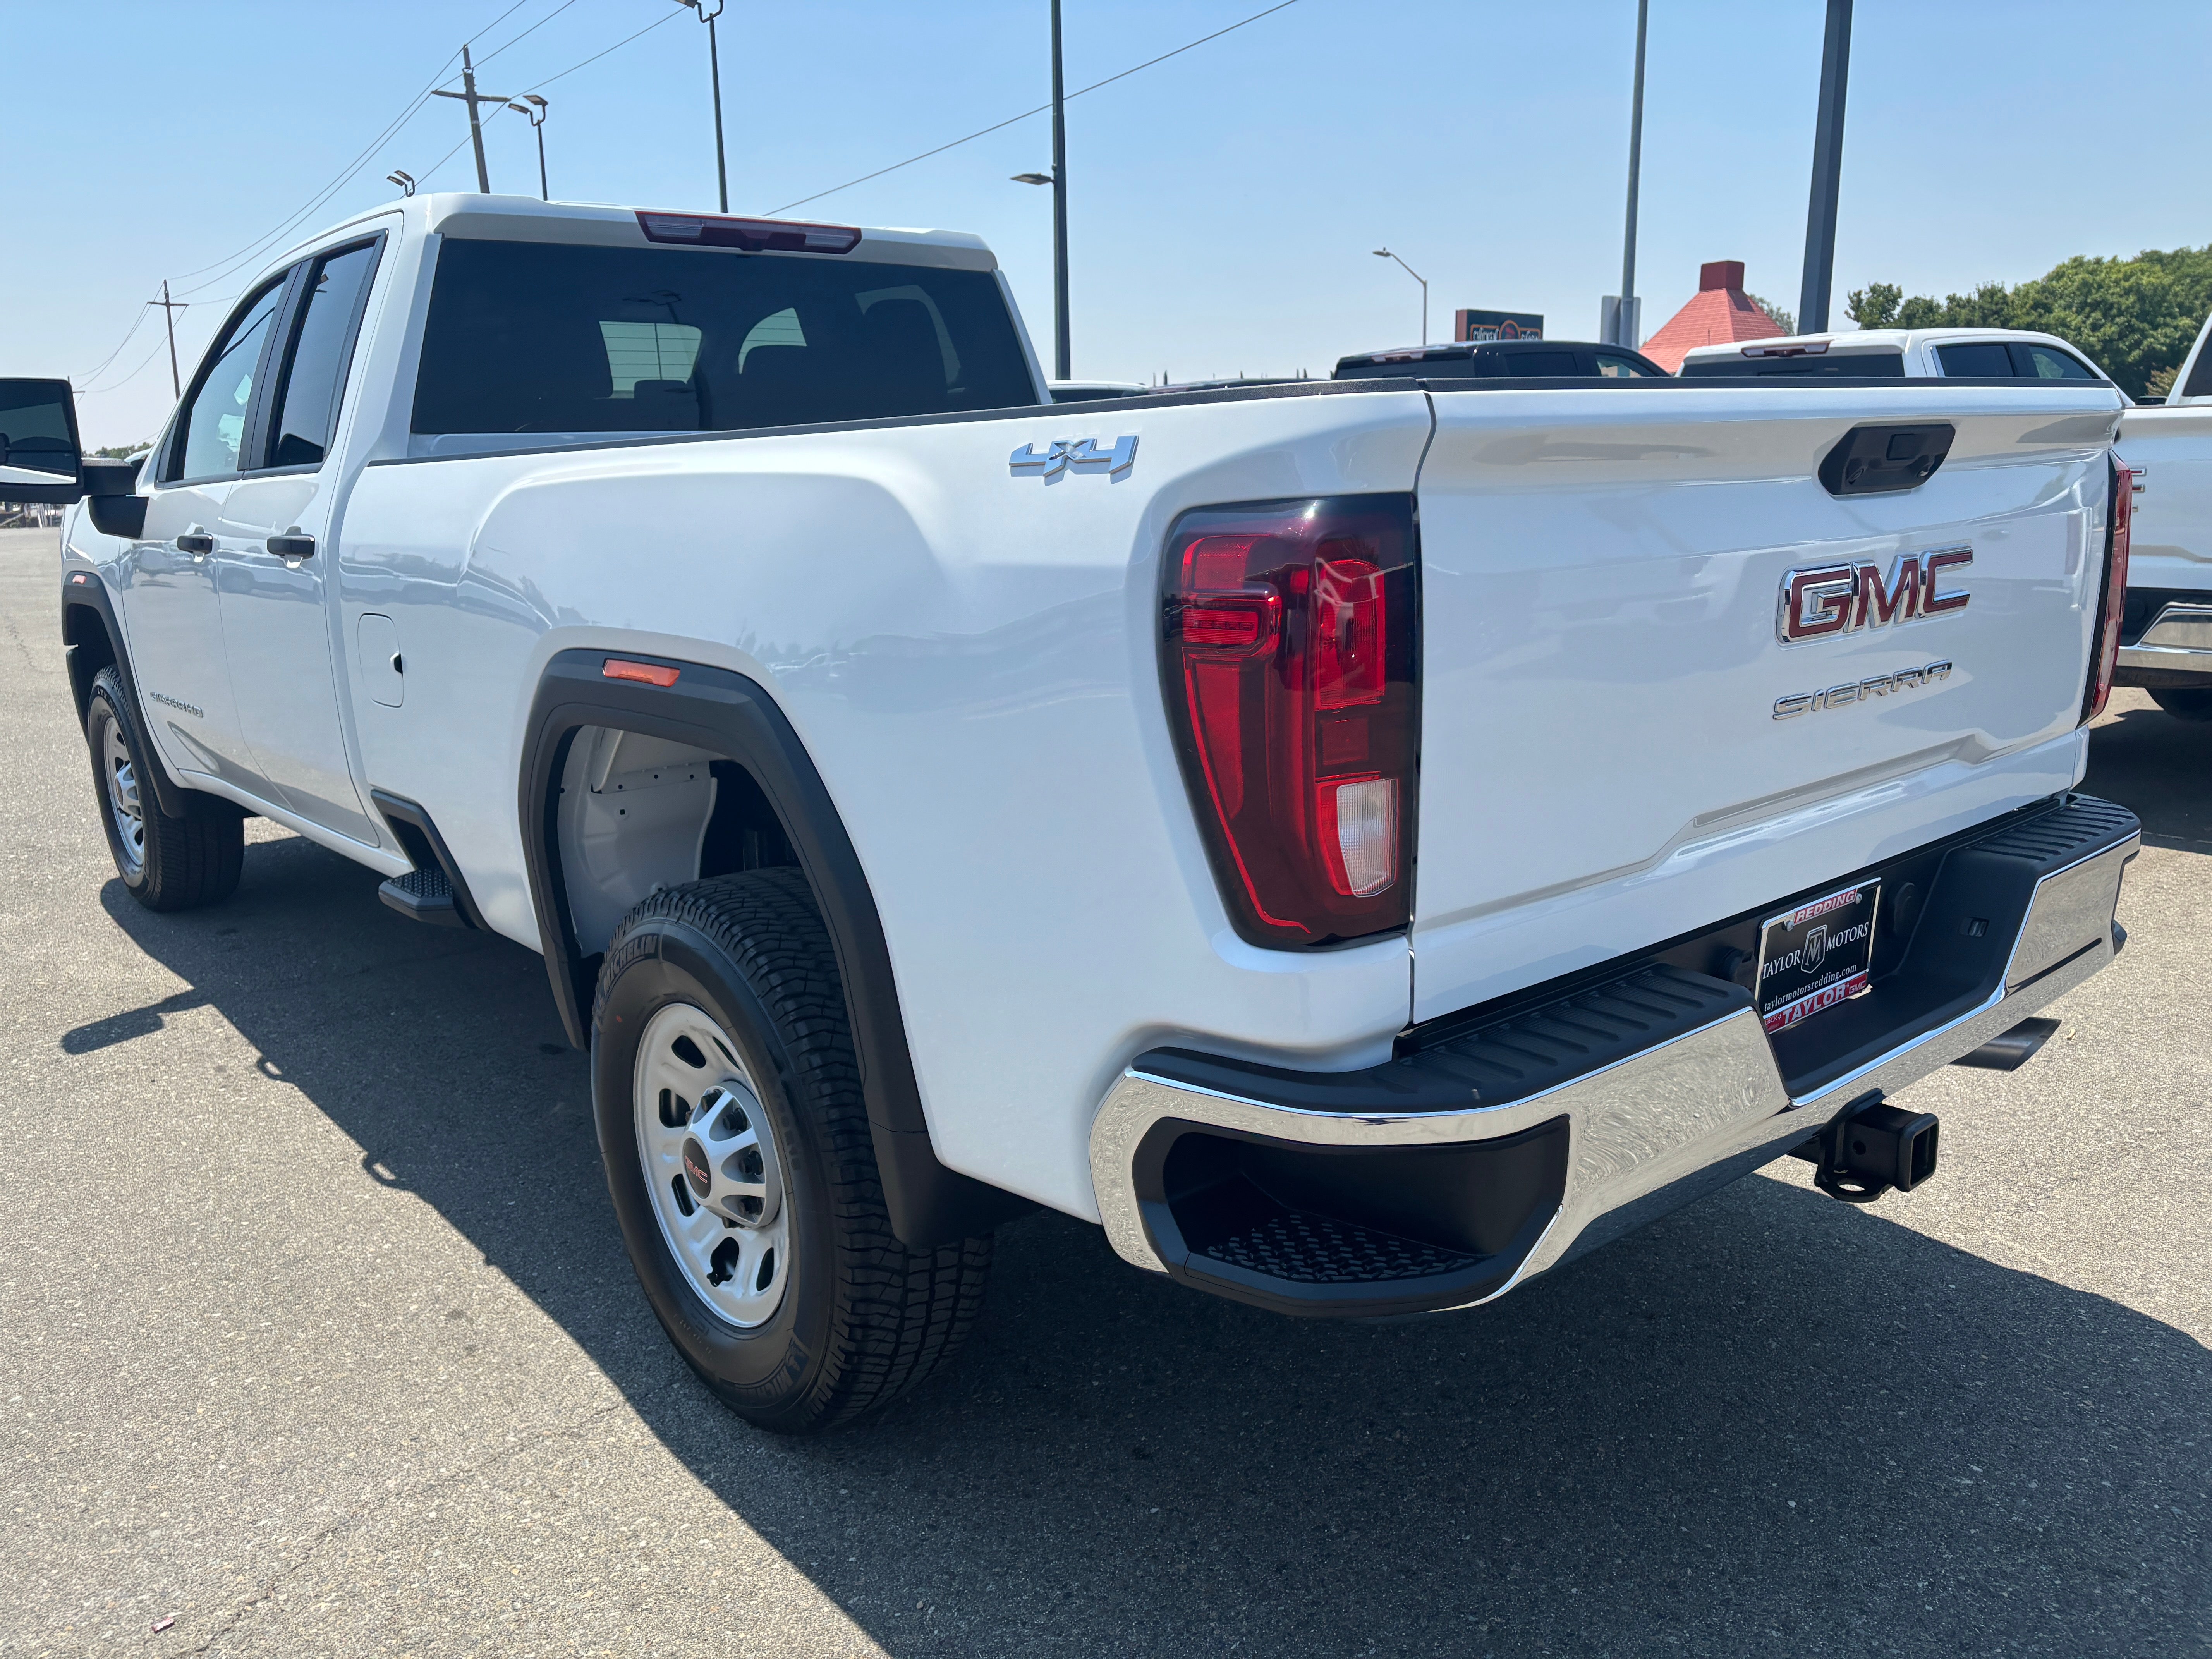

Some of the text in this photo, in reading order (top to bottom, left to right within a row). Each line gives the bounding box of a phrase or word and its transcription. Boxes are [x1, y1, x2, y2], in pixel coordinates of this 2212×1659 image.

[1776, 545, 1973, 646] GMC
[1772, 659, 1952, 720] SIERRA
[1796, 892, 1856, 922] REDDING
[1763, 950, 1801, 979] TAYLOR
[1826, 922, 1869, 951] MOTORS
[1764, 964, 1856, 1012] taylormotorsredding.com
[1783, 984, 1846, 1024] TAYLOR
[1849, 981, 1866, 994] GMC
[685, 1155, 708, 1184] GMC
